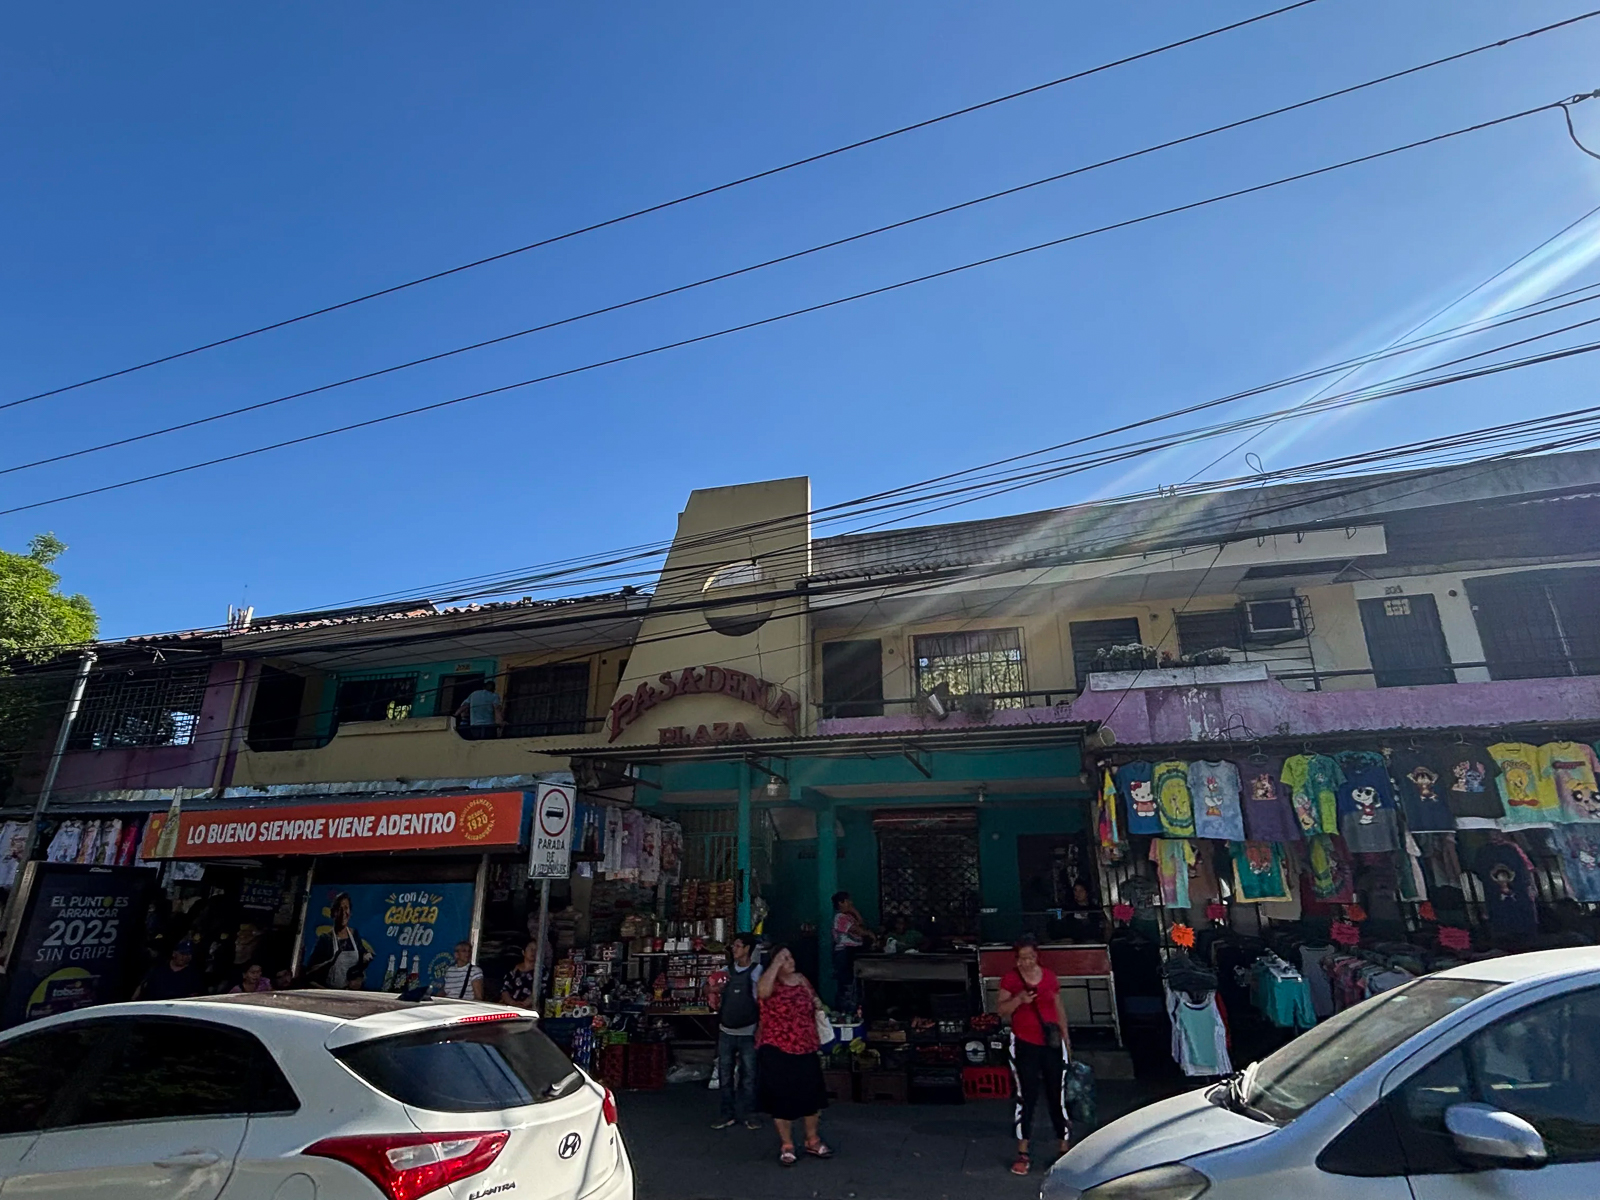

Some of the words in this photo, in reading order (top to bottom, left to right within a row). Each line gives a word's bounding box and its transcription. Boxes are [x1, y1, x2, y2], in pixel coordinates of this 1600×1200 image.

[607, 665, 800, 743] PASADENA
[657, 722, 753, 745] PLAZA
[187, 824, 206, 845] LO
[206, 821, 257, 844] BUENO
[259, 818, 326, 842] SIEMPRE
[328, 815, 375, 838] VIENE
[375, 810, 456, 836] ADENTRO
[467, 813, 488, 831] 1920
[537, 838, 565, 850] PARADA
[546, 851, 555, 862] DE
[50, 895, 65, 908] EL
[114, 896, 130, 908] ES
[398, 891, 417, 904] con
[418, 890, 429, 905] la
[57, 908, 119, 918] ARRANCAR
[42, 919, 120, 946] 2025
[386, 925, 400, 937] en
[397, 923, 434, 946] alto
[35, 948, 64, 962] SIN
[69, 945, 116, 960] GRIPE
[468, 1182, 516, 1200] ELANTRA
